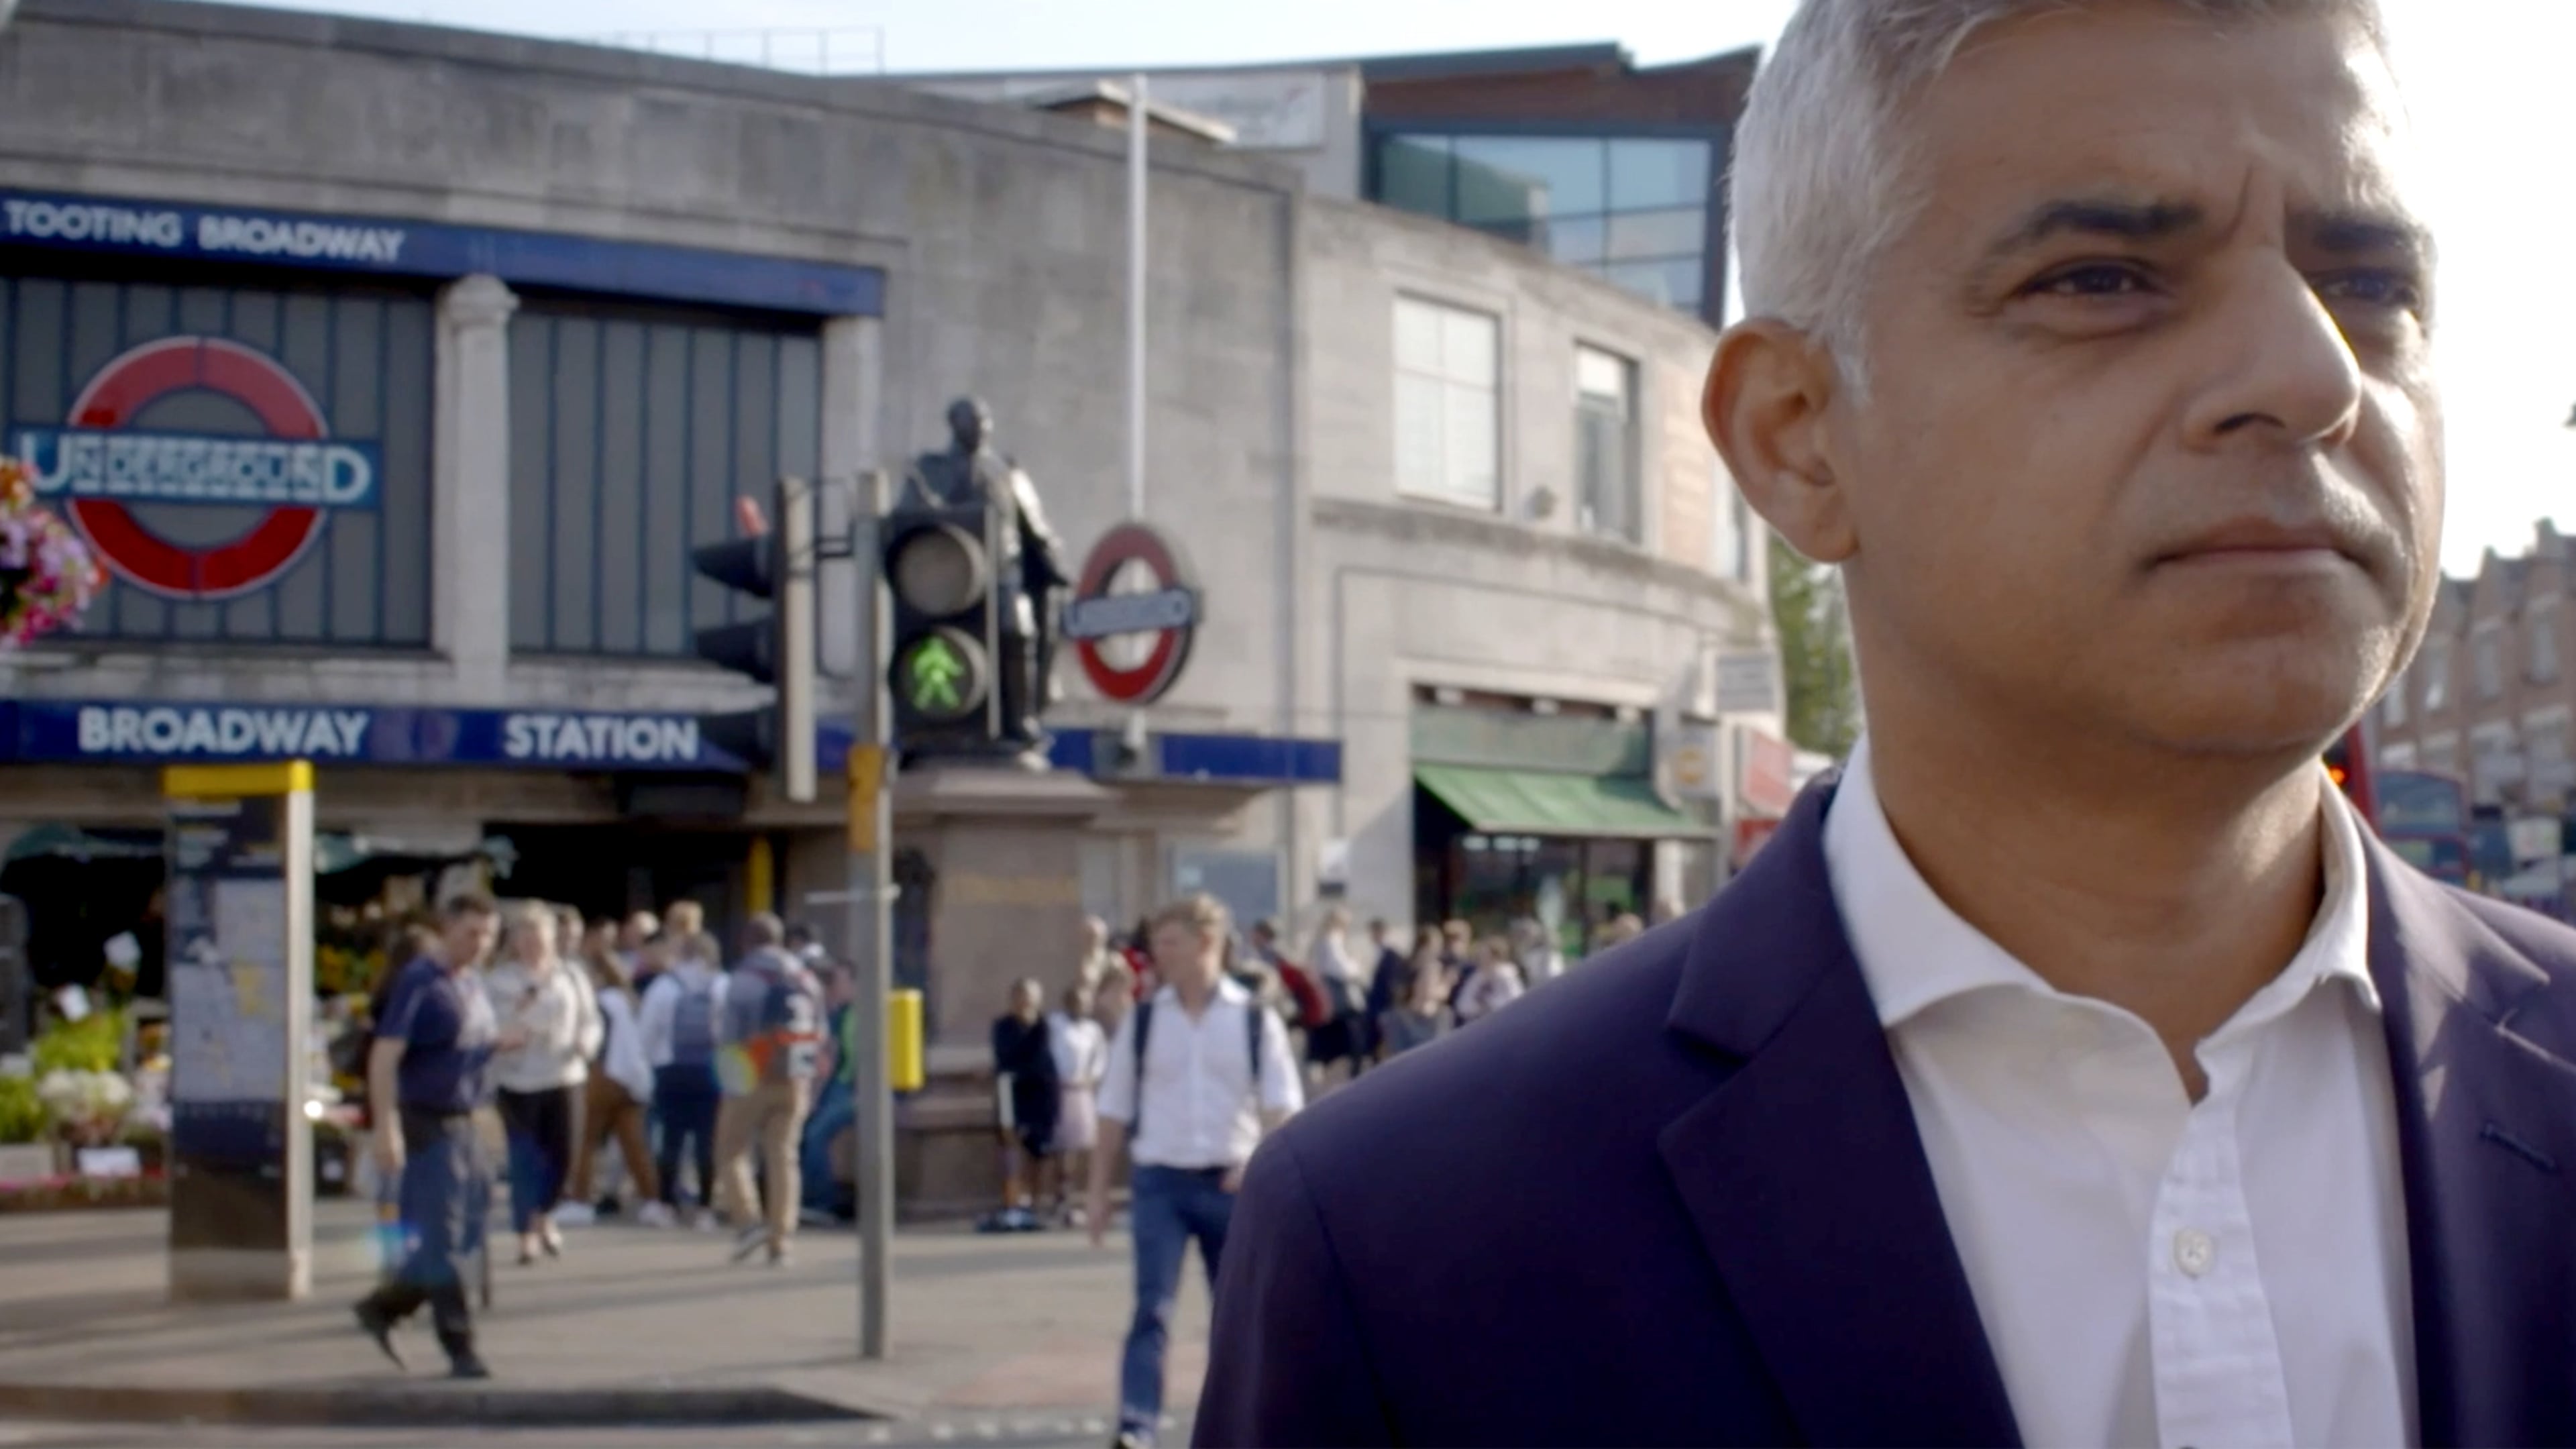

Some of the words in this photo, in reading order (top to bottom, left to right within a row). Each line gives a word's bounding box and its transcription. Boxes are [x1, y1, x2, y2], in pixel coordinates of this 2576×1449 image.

[4, 200, 182, 248] TOOTING
[199, 216, 405, 262] BROADWAY
[78, 706, 368, 755] BROADWAY
[505, 714, 698, 760] STATION
